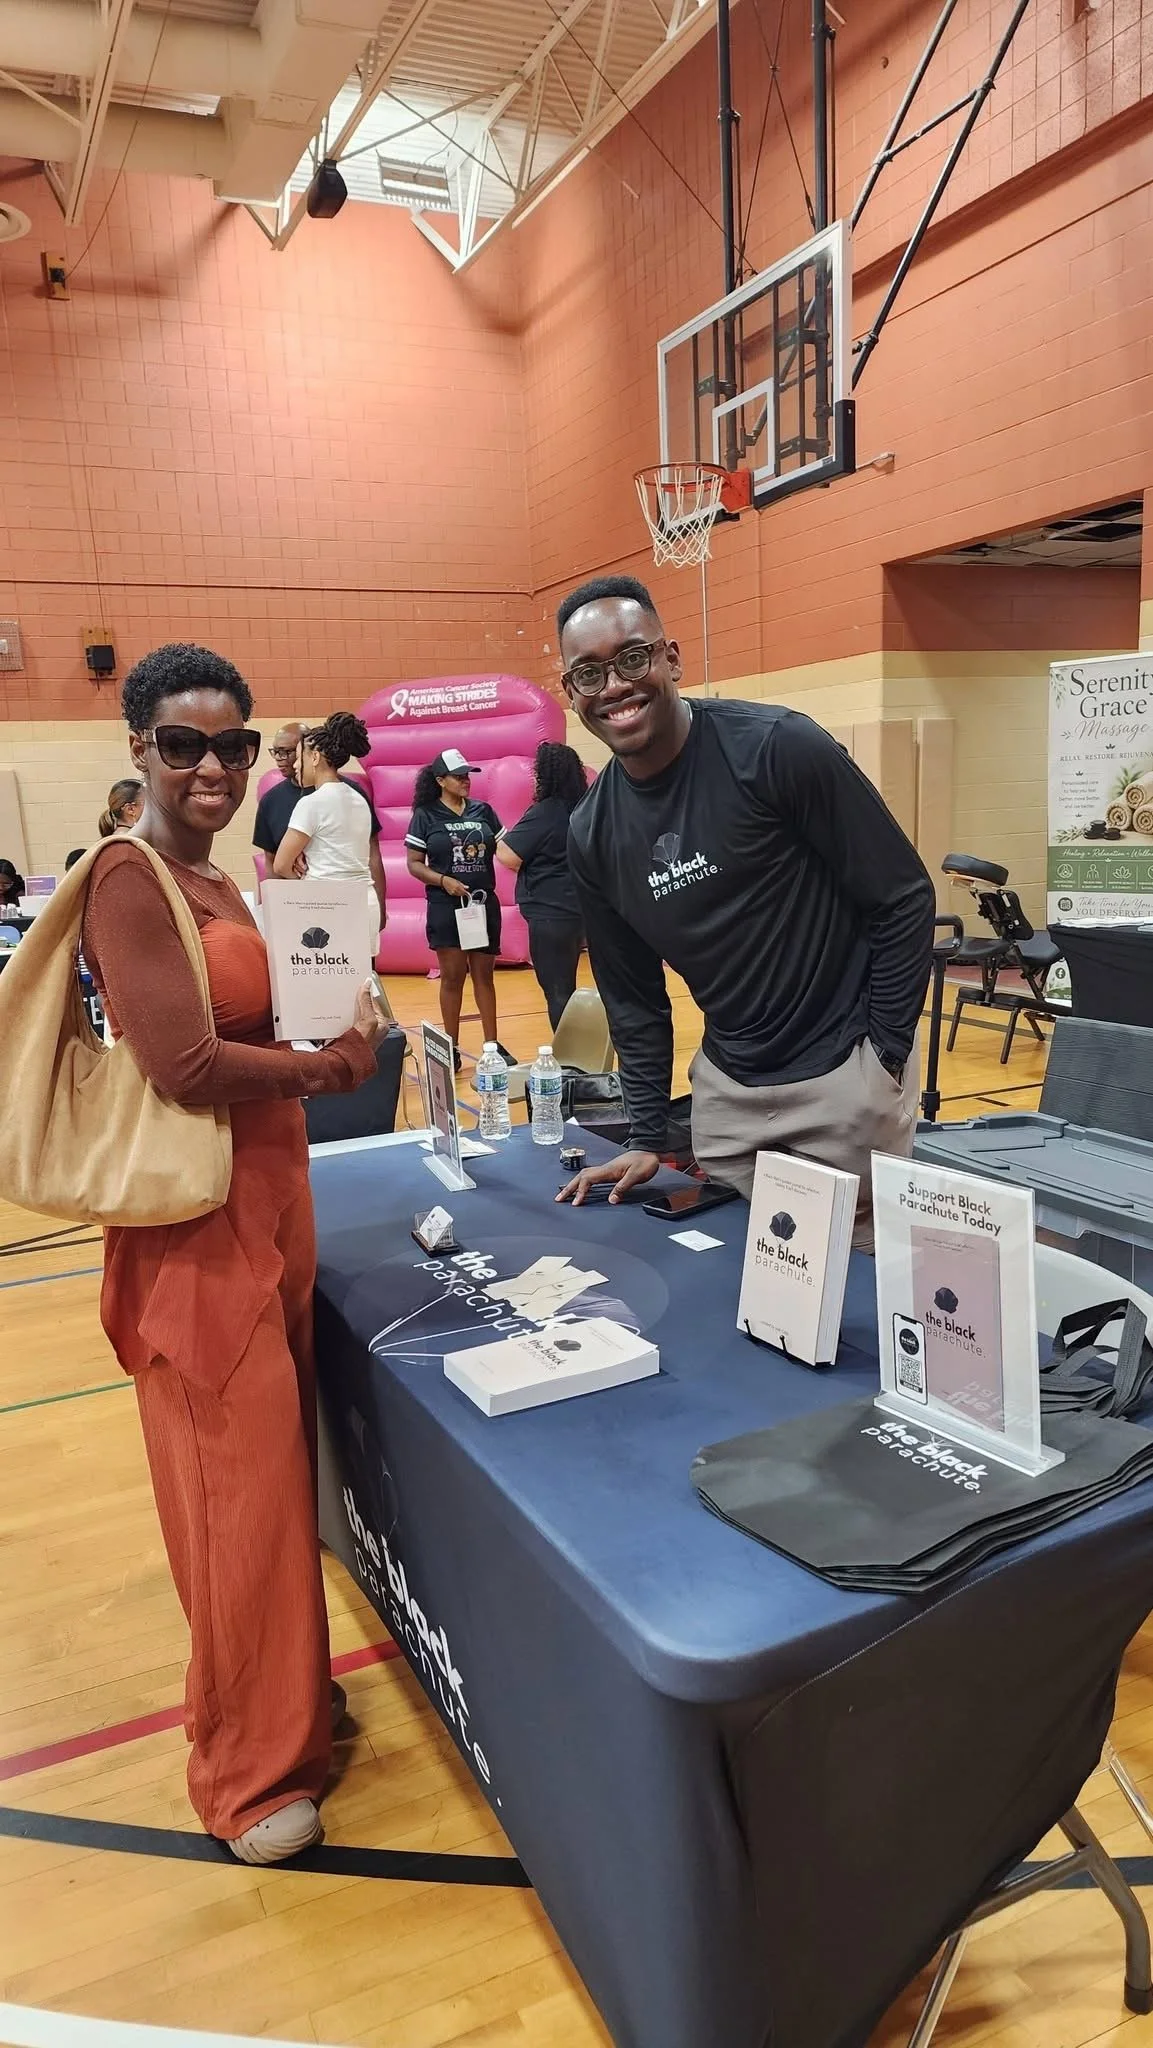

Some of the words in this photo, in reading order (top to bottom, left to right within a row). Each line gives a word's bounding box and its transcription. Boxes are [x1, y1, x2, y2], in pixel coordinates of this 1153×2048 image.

[409, 692, 453, 706] MAKING
[455, 688, 497, 703] STRIDES
[410, 687, 444, 695] American
[409, 706, 442, 718] Against
[442, 705, 468, 714] Breast
[1080, 695, 1148, 719] Grace
[1074, 719, 1150, 744] Massage
[444, 821, 482, 831] RONDO
[1063, 848, 1085, 859] Healing
[648, 870, 670, 888] the
[671, 852, 709, 878] black
[653, 864, 724, 902] parachute.
[1076, 908, 1096, 916] YOU
[1099, 908, 1144, 918] DESERVE
[1078, 896, 1096, 906] Take
[1098, 896, 1118, 907] Time
[290, 952, 312, 965] the
[314, 952, 350, 965] black
[291, 965, 360, 976] parachute.
[907, 1181, 956, 1206] Support
[958, 1194, 992, 1216] Black
[899, 1193, 959, 1222] Parachute
[962, 1211, 1001, 1236] Today
[450, 1251, 498, 1280] the
[756, 1236, 775, 1257] the
[777, 1244, 809, 1272] black
[755, 1254, 816, 1288] parachute.
[413, 1260, 533, 1340] parachut
[926, 1310, 942, 1328] the
[944, 1316, 976, 1343] black
[540, 1347, 568, 1366] black
[926, 1326, 987, 1359] parachute.
[860, 1427, 981, 1494] parachute.
[879, 1422, 919, 1446] the
[916, 1441, 989, 1480] black
[342, 1486, 382, 1569] the
[382, 1533, 471, 1720] black
[353, 1543, 503, 1808] parachute.
